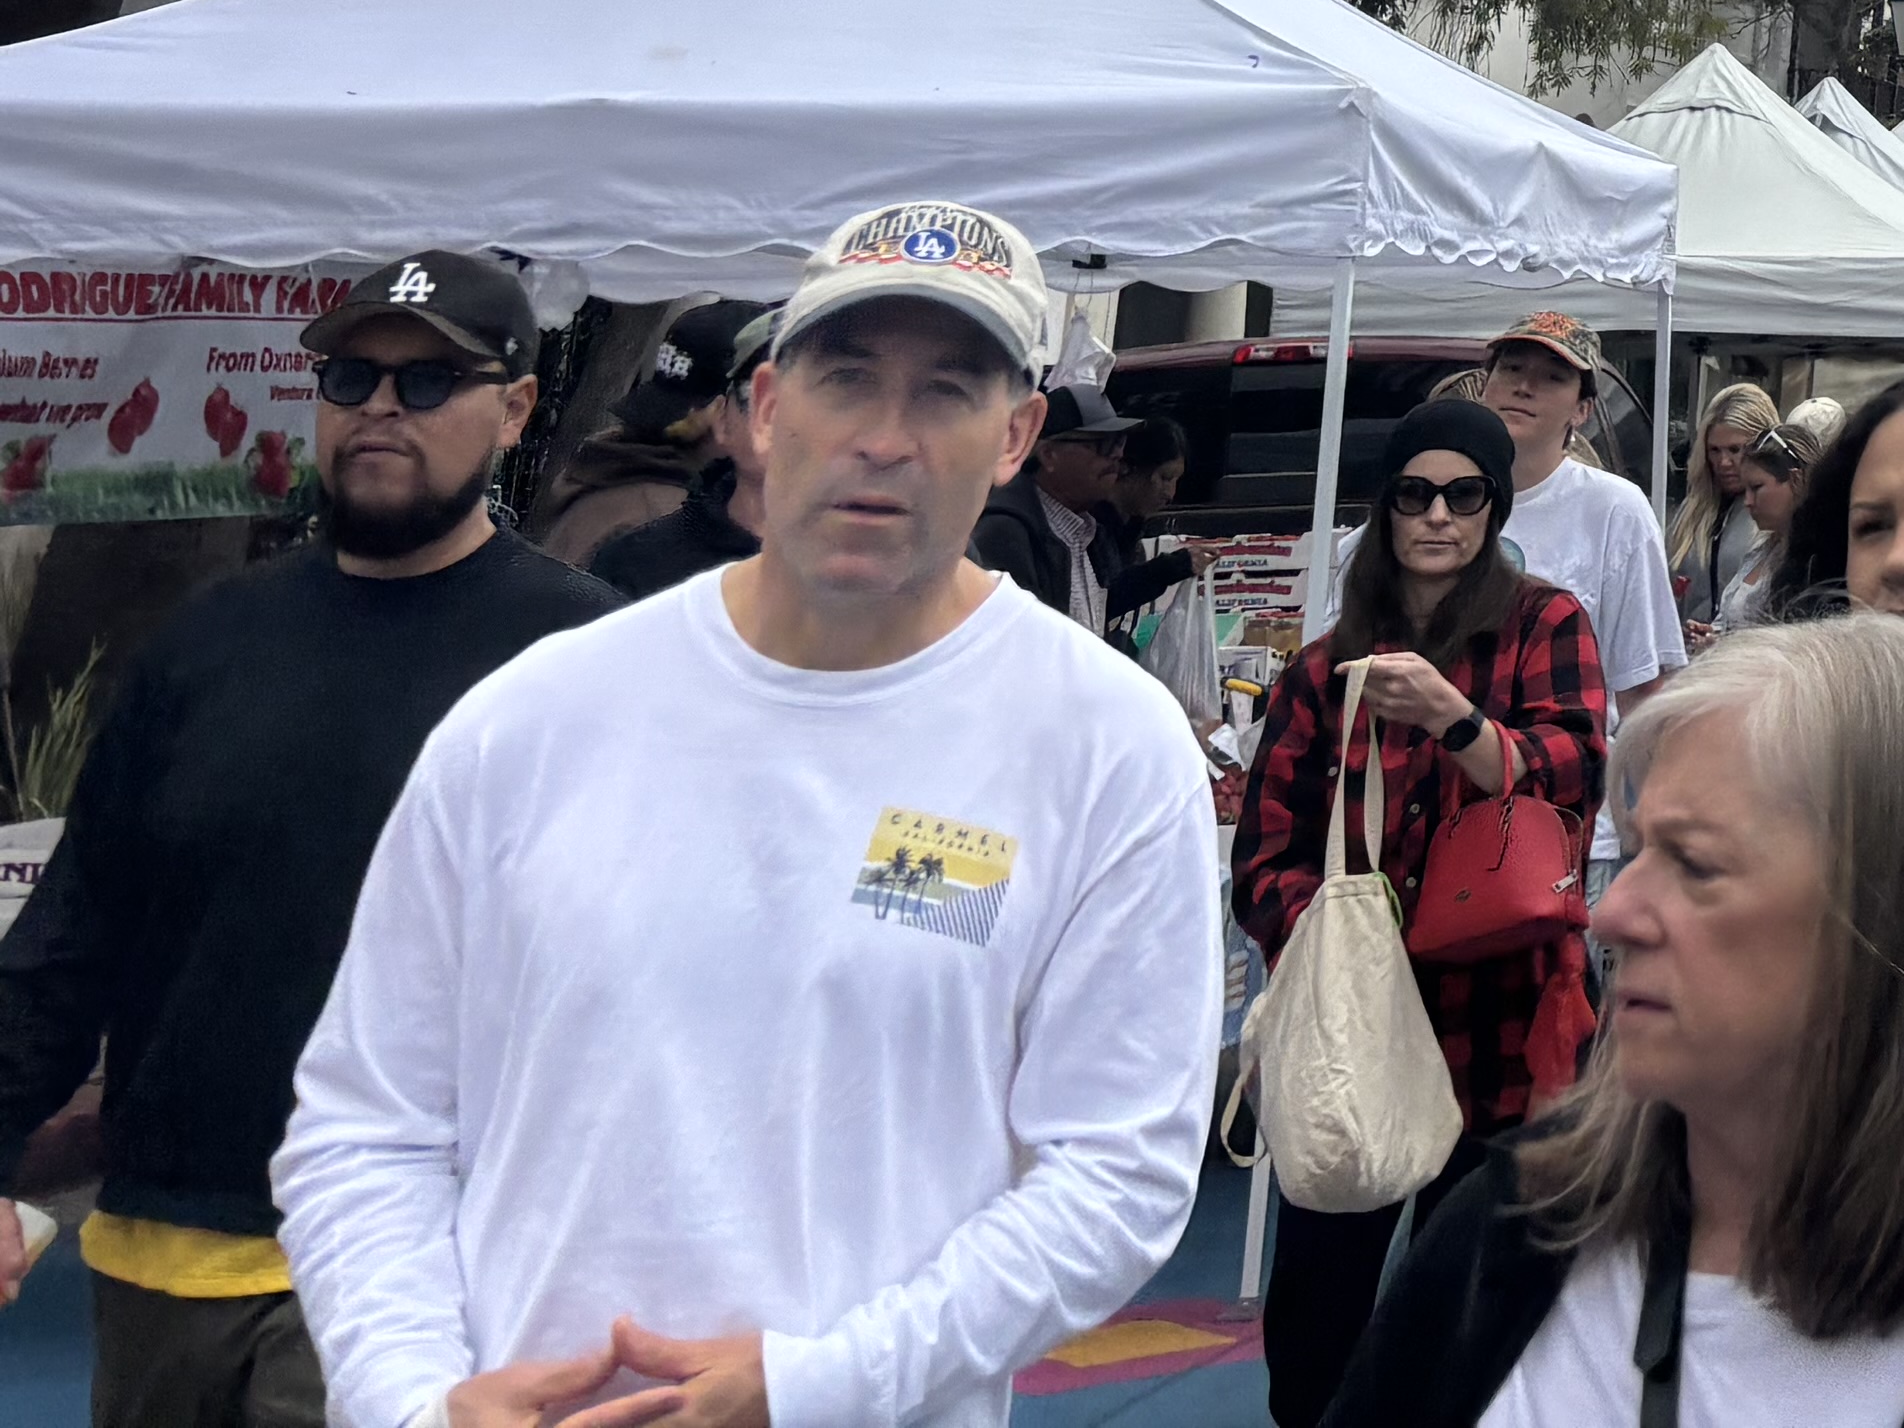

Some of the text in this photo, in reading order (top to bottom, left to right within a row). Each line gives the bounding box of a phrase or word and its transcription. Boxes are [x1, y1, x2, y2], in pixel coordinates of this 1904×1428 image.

[914, 231, 945, 258] LA
[0, 270, 172, 316] ODRIGUEZ
[389, 262, 436, 303] LA
[206, 346, 256, 373] From
[891, 813, 1006, 852] CARMEL
